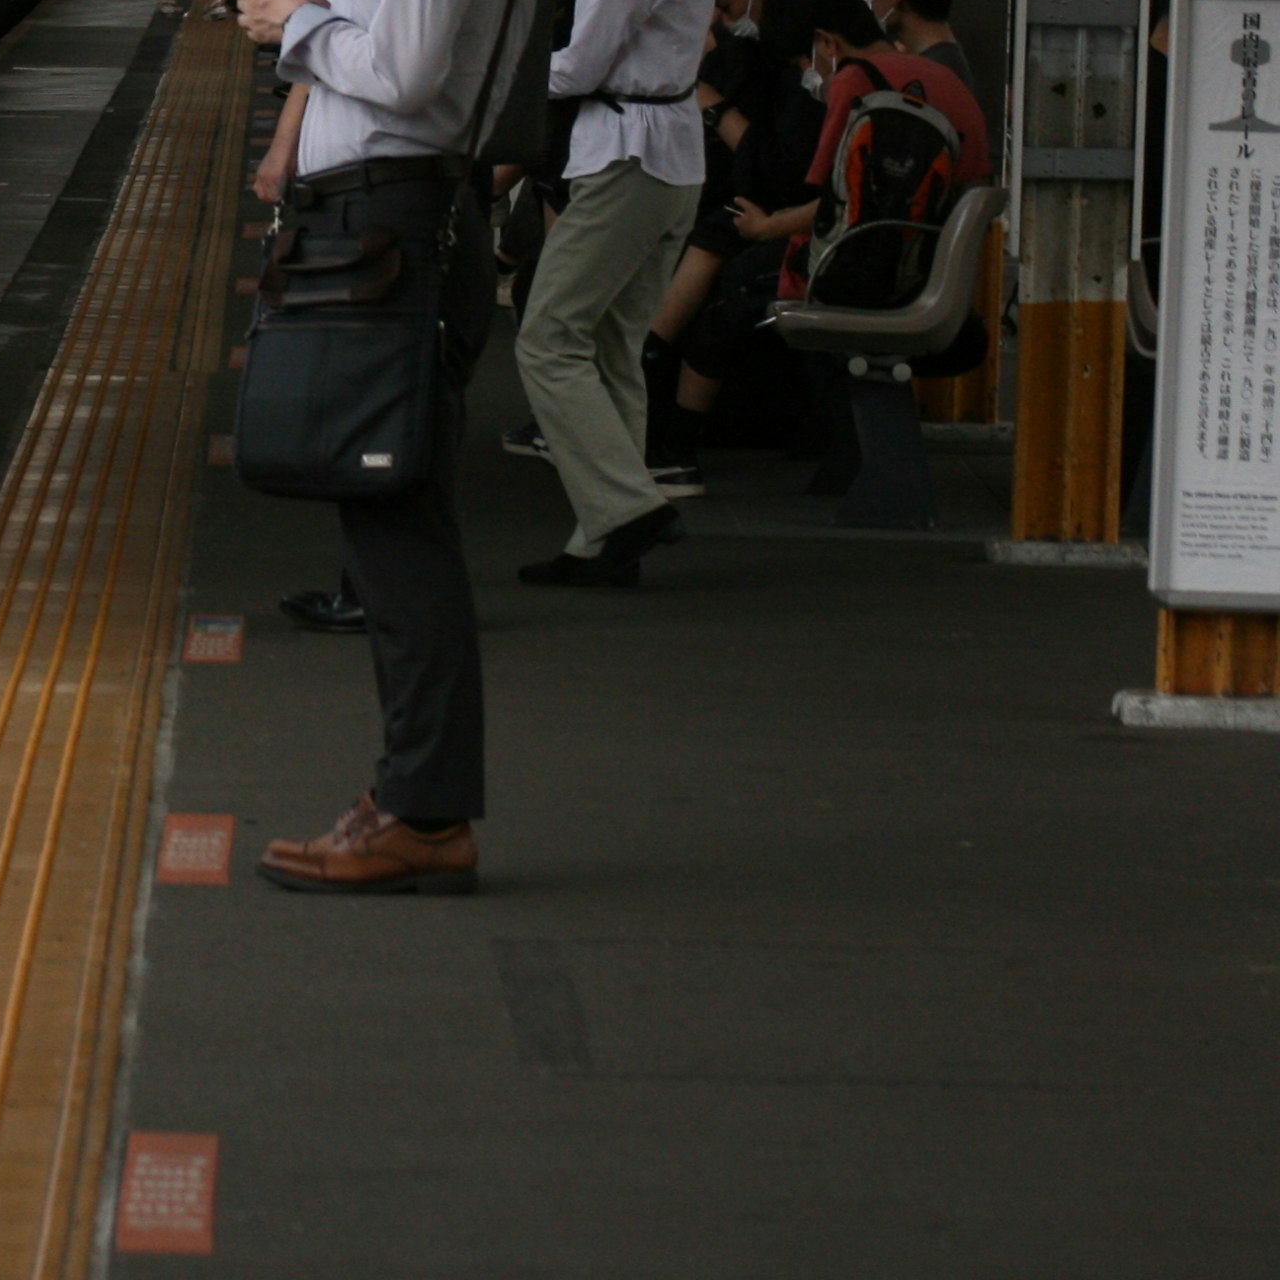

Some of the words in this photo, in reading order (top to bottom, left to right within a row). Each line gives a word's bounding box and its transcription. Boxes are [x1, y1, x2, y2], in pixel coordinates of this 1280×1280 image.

[1237, 12, 1261, 159] 国内最古のレール
